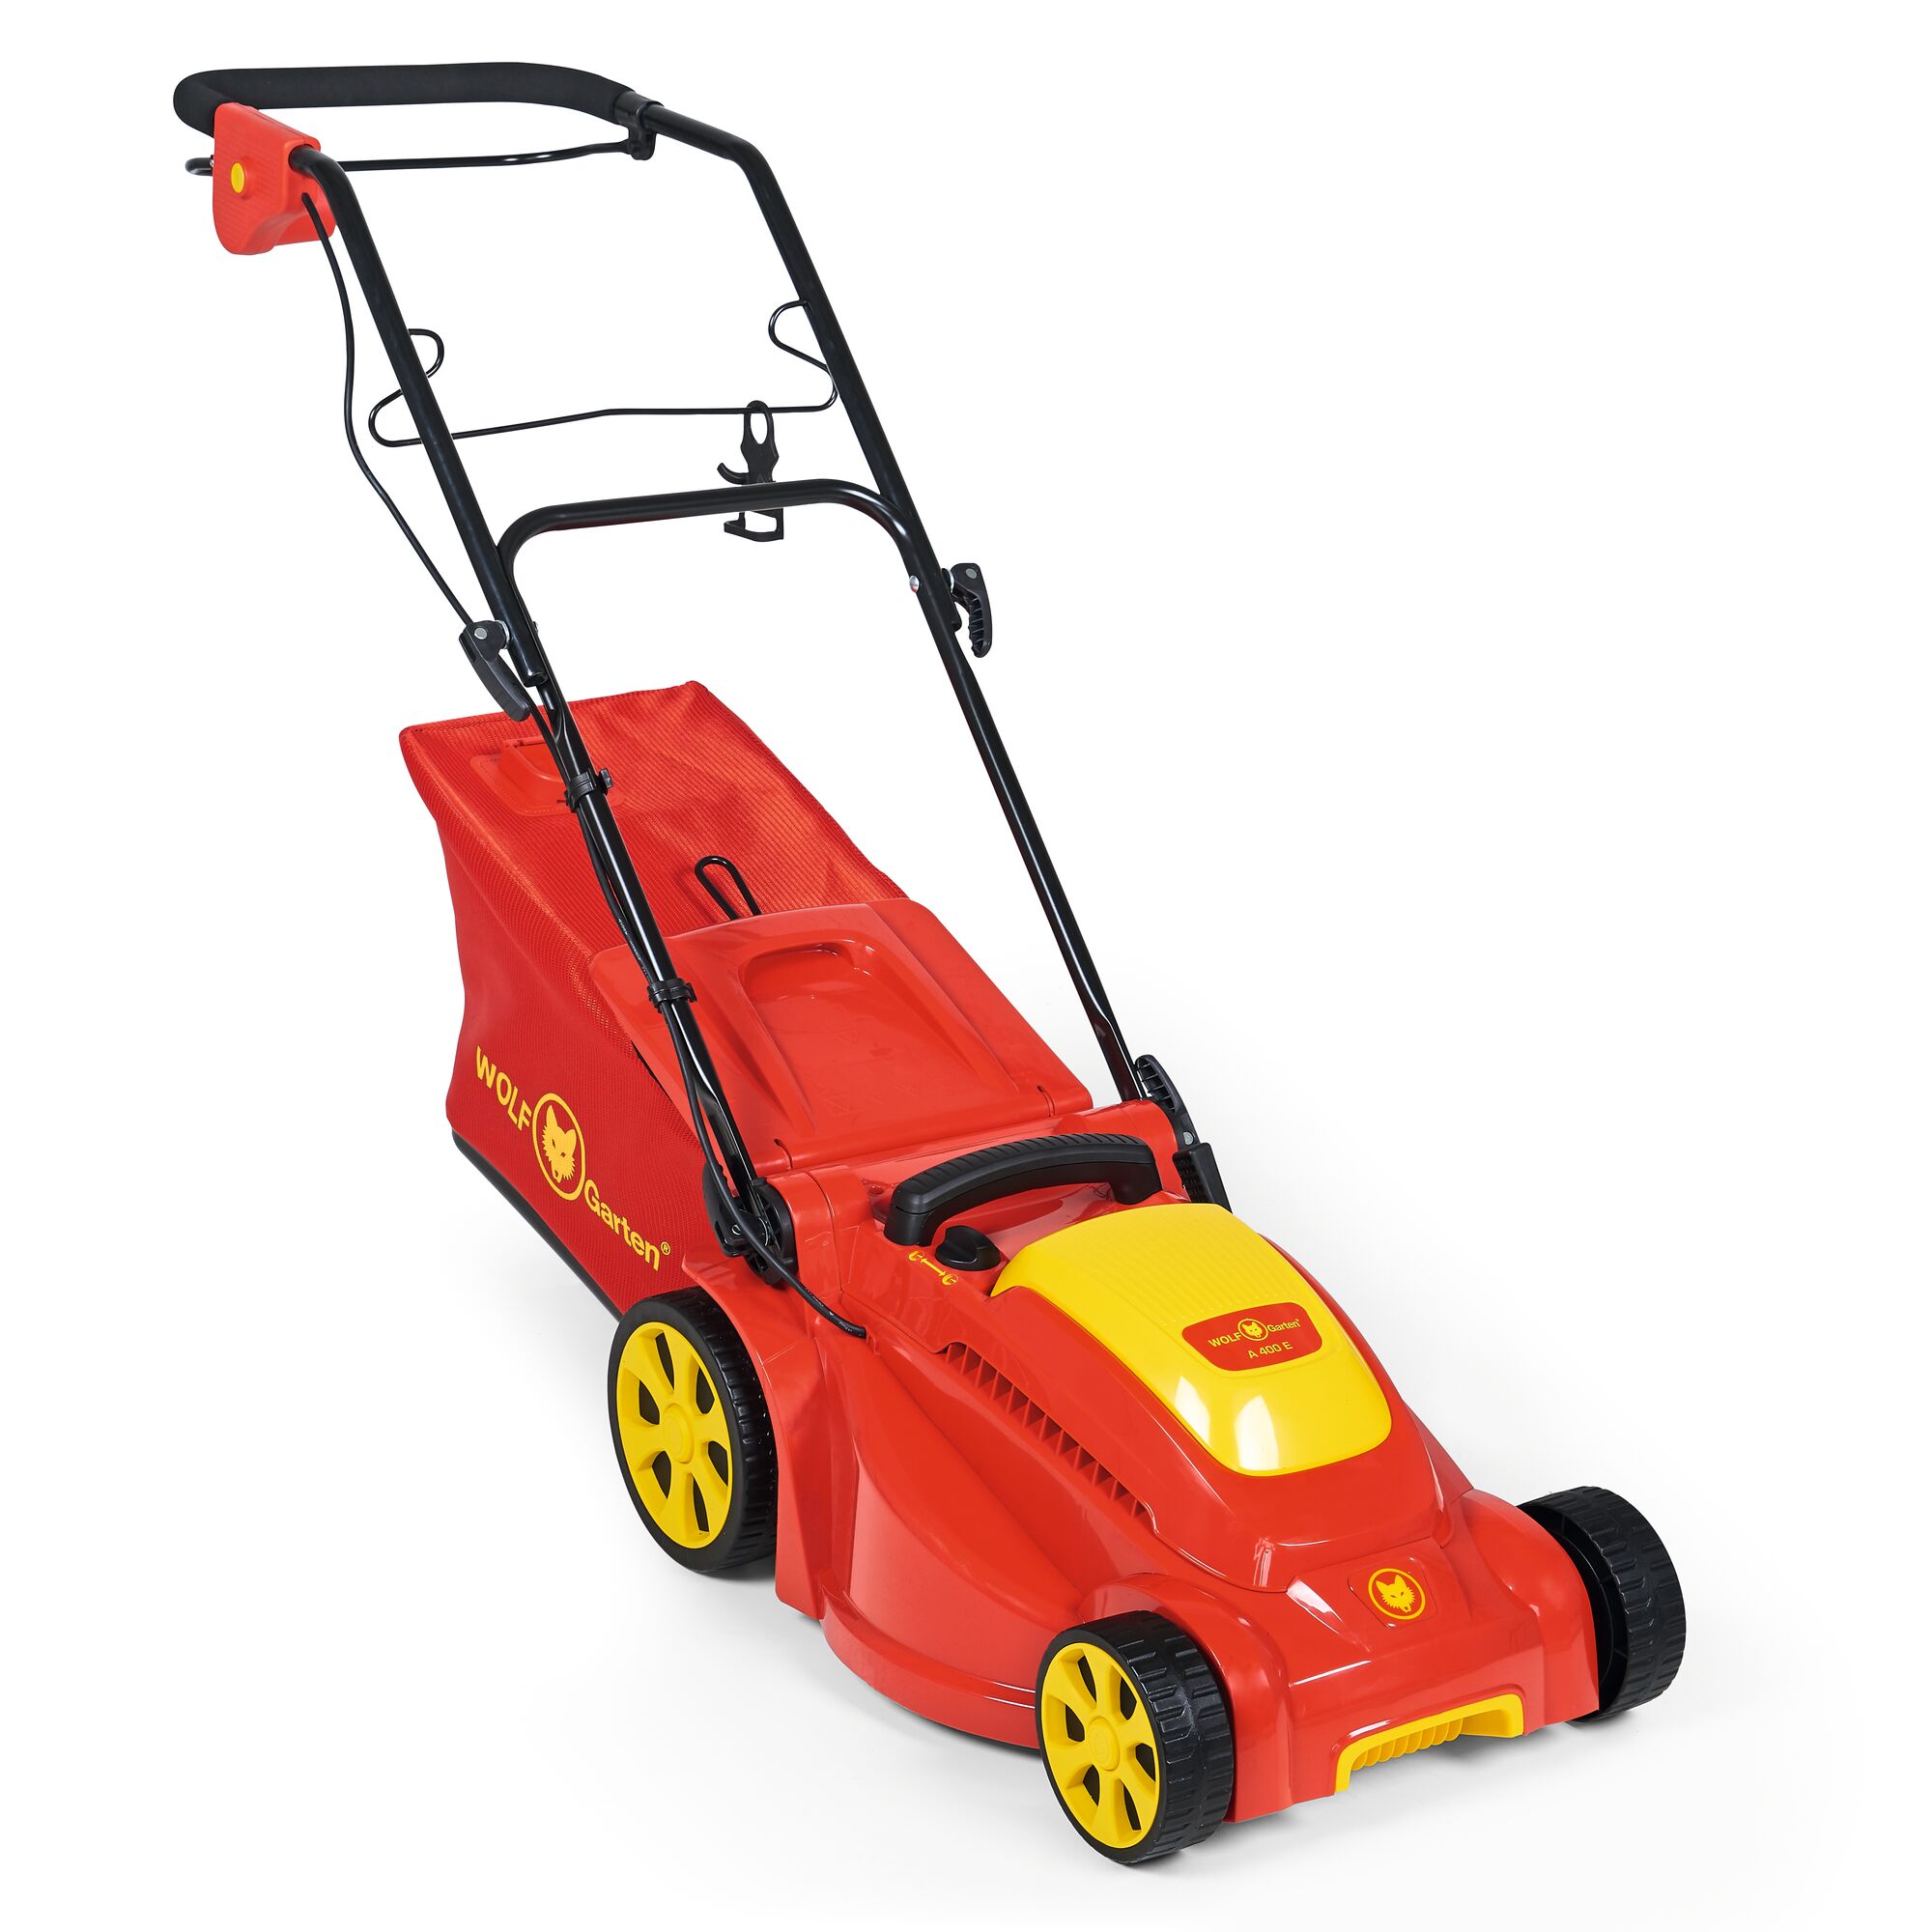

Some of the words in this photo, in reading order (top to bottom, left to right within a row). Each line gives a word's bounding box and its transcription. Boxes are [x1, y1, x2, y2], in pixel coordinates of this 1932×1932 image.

[476, 1045, 531, 1130] WOLF
[1208, 1332, 1242, 1347] WOLF
[1260, 1345, 1282, 1355] 400
